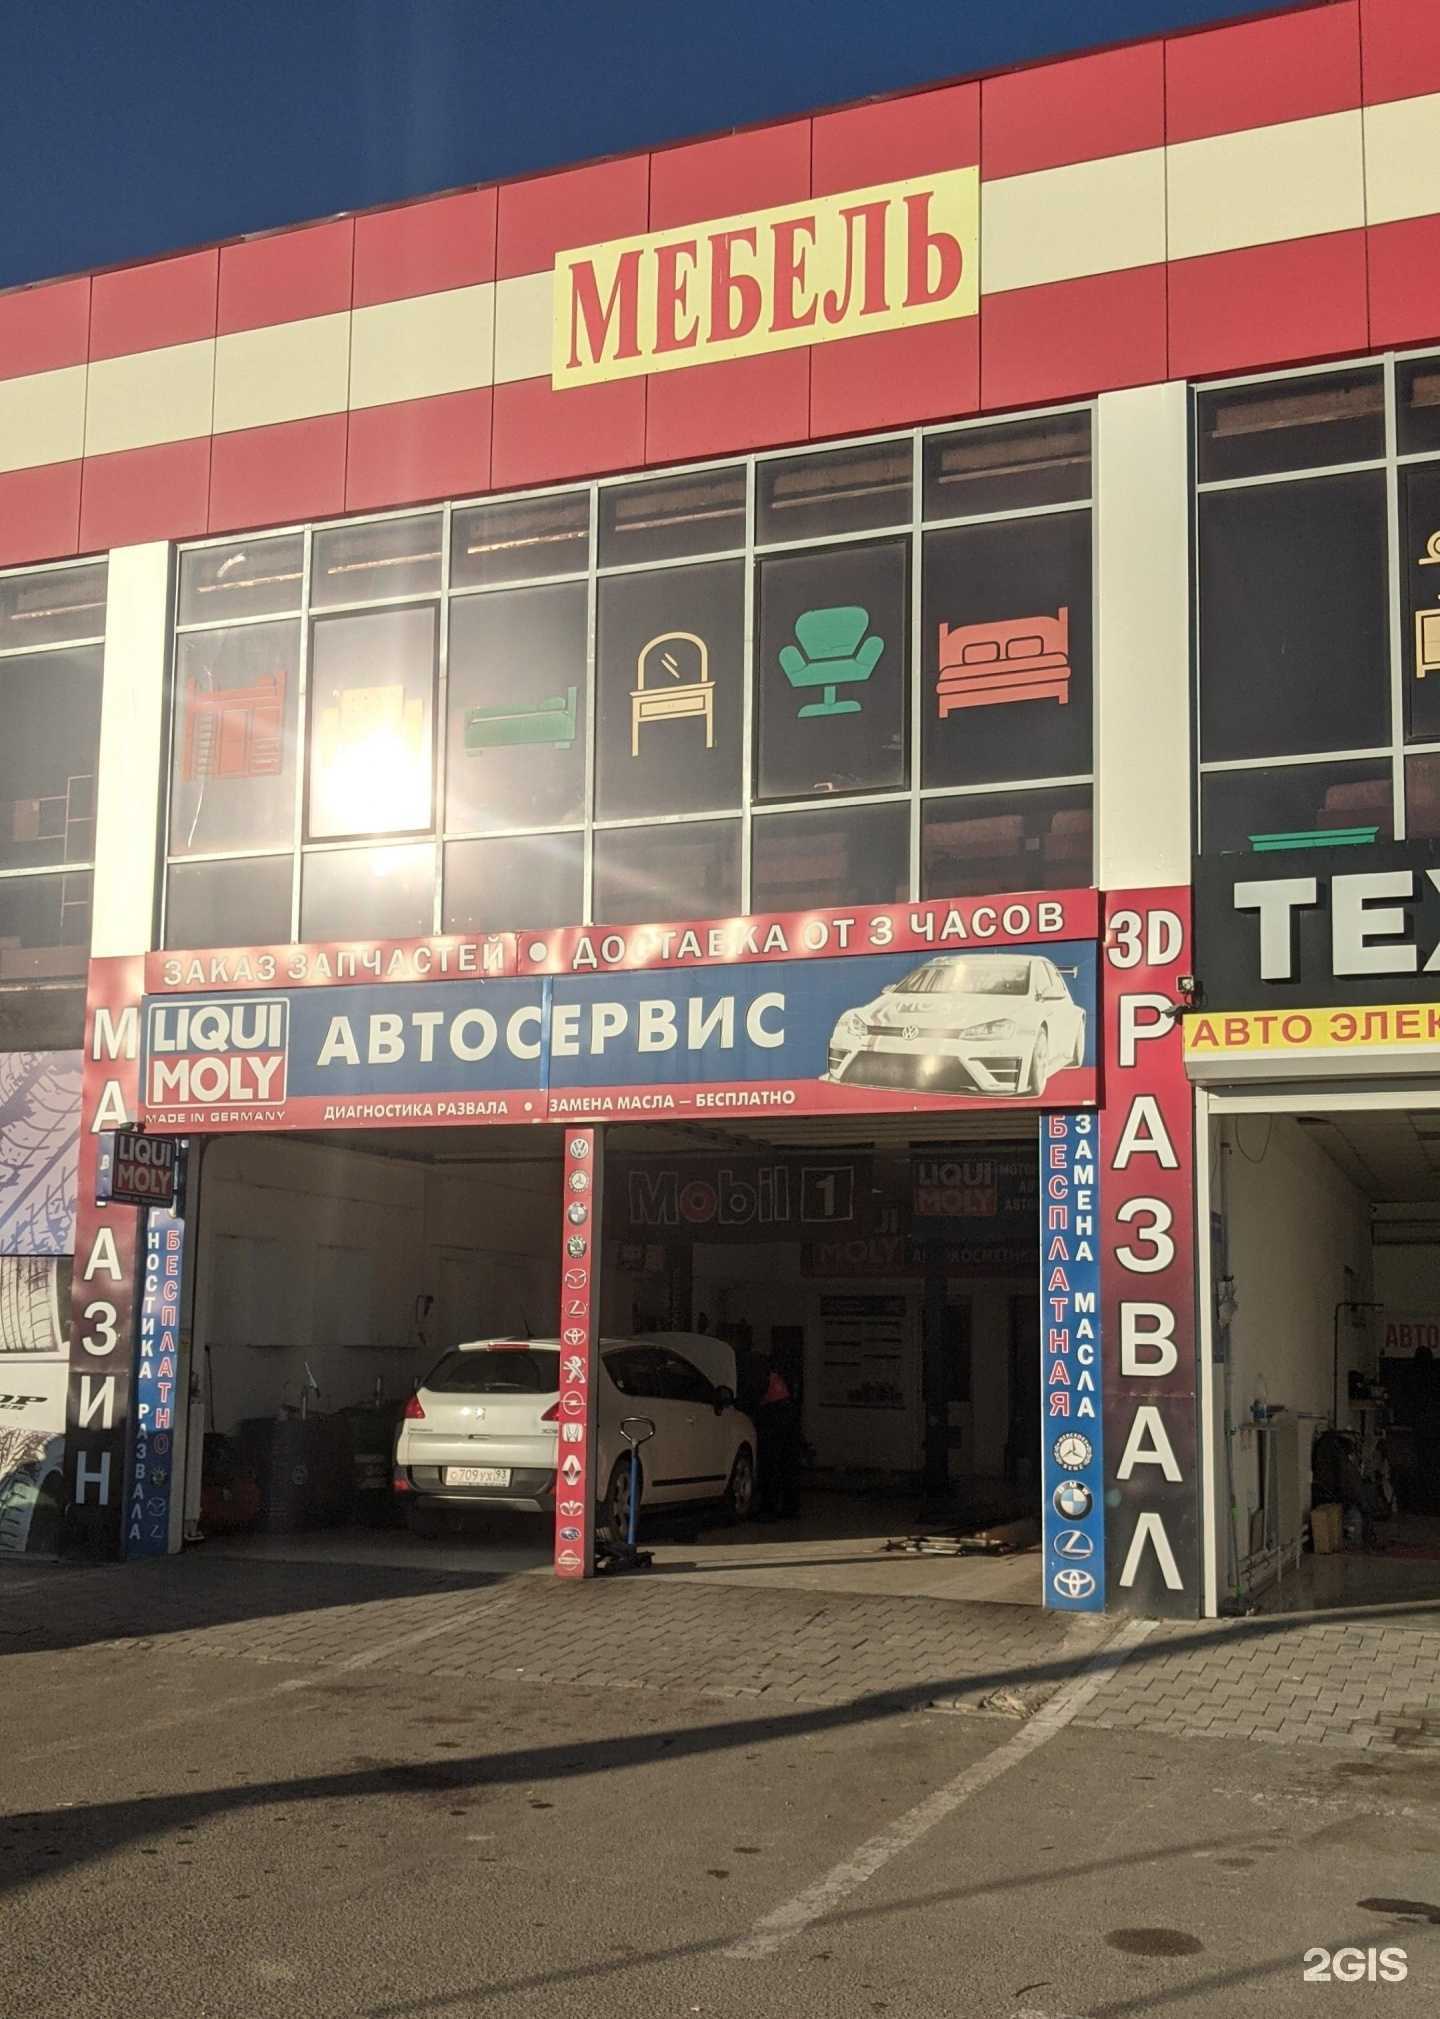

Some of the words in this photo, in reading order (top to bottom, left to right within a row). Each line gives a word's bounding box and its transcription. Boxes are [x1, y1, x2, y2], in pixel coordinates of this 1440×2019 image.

[566, 191, 963, 368] МЕБЕЛЬ
[803, 919, 854, 950] ОТ
[909, 902, 1064, 941] ЧАСОВ
[1107, 909, 1184, 969] 3D
[1234, 868, 1440, 979] ТЕ
[164, 955, 277, 986] ЗАКАЗ
[287, 936, 504, 979] ЗАПЧАСТЕЙ
[154, 1004, 282, 1052] LIQUI
[316, 992, 785, 1066] АВТОСЕРВИС
[1191, 1014, 1312, 1047] АВТО
[153, 1056, 283, 1103] MOLY
[324, 1103, 433, 1121] ДИАГНОСТИКА
[437, 1101, 508, 1117] РАЗВАЛА
[549, 1097, 613, 1112] ЗАМЕНА
[617, 1095, 674, 1110] МАСЛА
[696, 1090, 796, 1107] БЕСПЛАТНО
[145, 1111, 186, 1124] MADE
[190, 1111, 206, 1123] IN
[209, 1110, 285, 1122] GERMANY
[117, 1165, 171, 1194] MOLY
[119, 1136, 171, 1168] LIQUI
[629, 1166, 789, 1225] Mobil
[1073, 1114, 1095, 1261] ЗАМЕНА
[75, 1008, 136, 1505] МААЗИН
[1048, 1115, 1071, 1417] БЕСПЛАТНАЯ
[1111, 993, 1184, 1591] РАЗВАЛ
[154, 1230, 180, 1454] БЕСПЛАТНО
[1075, 1292, 1095, 1418] МАСЛА
[129, 1404, 150, 1539] РАЗВАЛА
